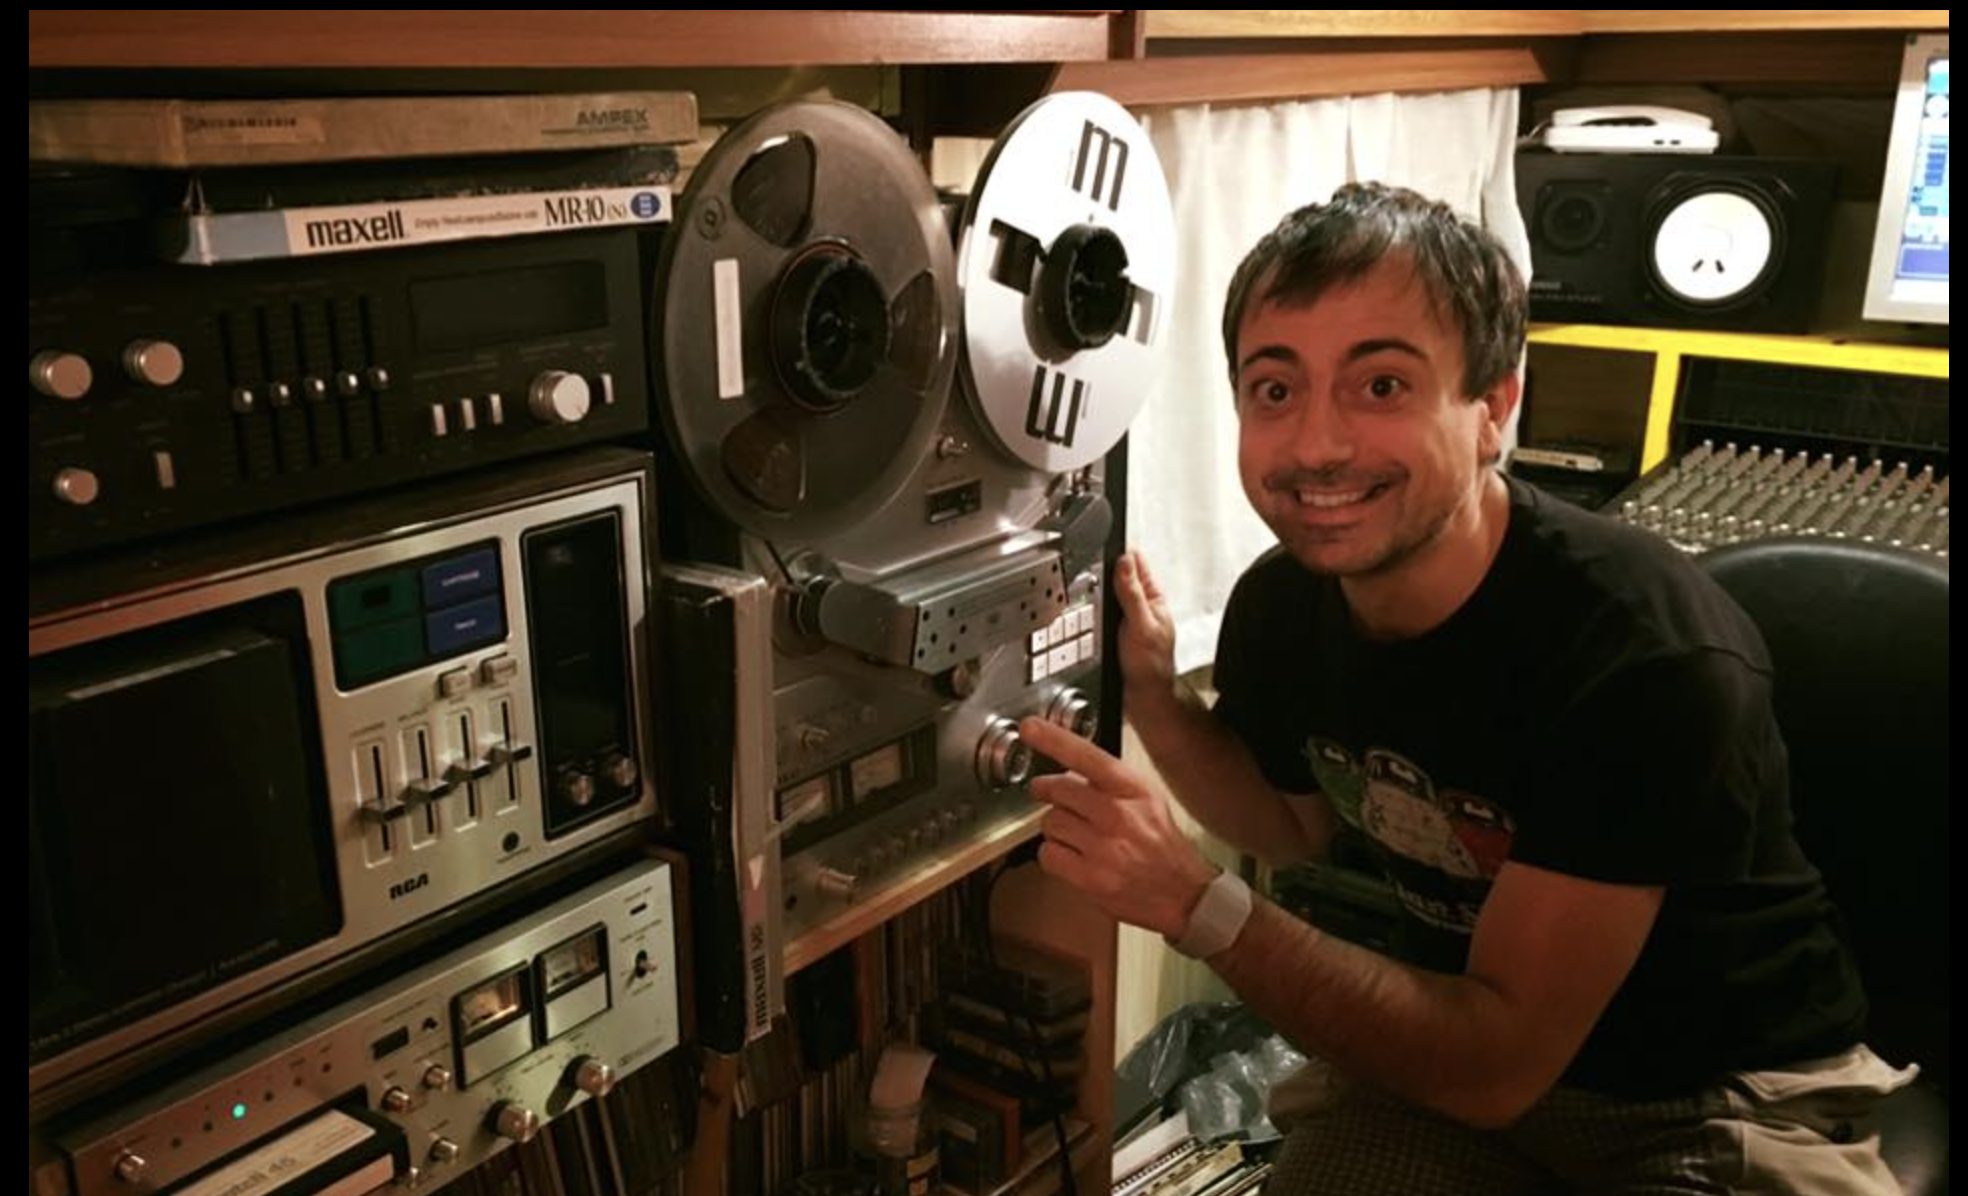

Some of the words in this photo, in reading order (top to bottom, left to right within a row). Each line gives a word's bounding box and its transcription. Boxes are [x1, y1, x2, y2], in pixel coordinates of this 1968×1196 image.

[577, 109, 649, 126] AMPEX
[306, 209, 404, 247] maxell
[389, 873, 429, 899] RCA
[751, 955, 767, 1027] maxell
